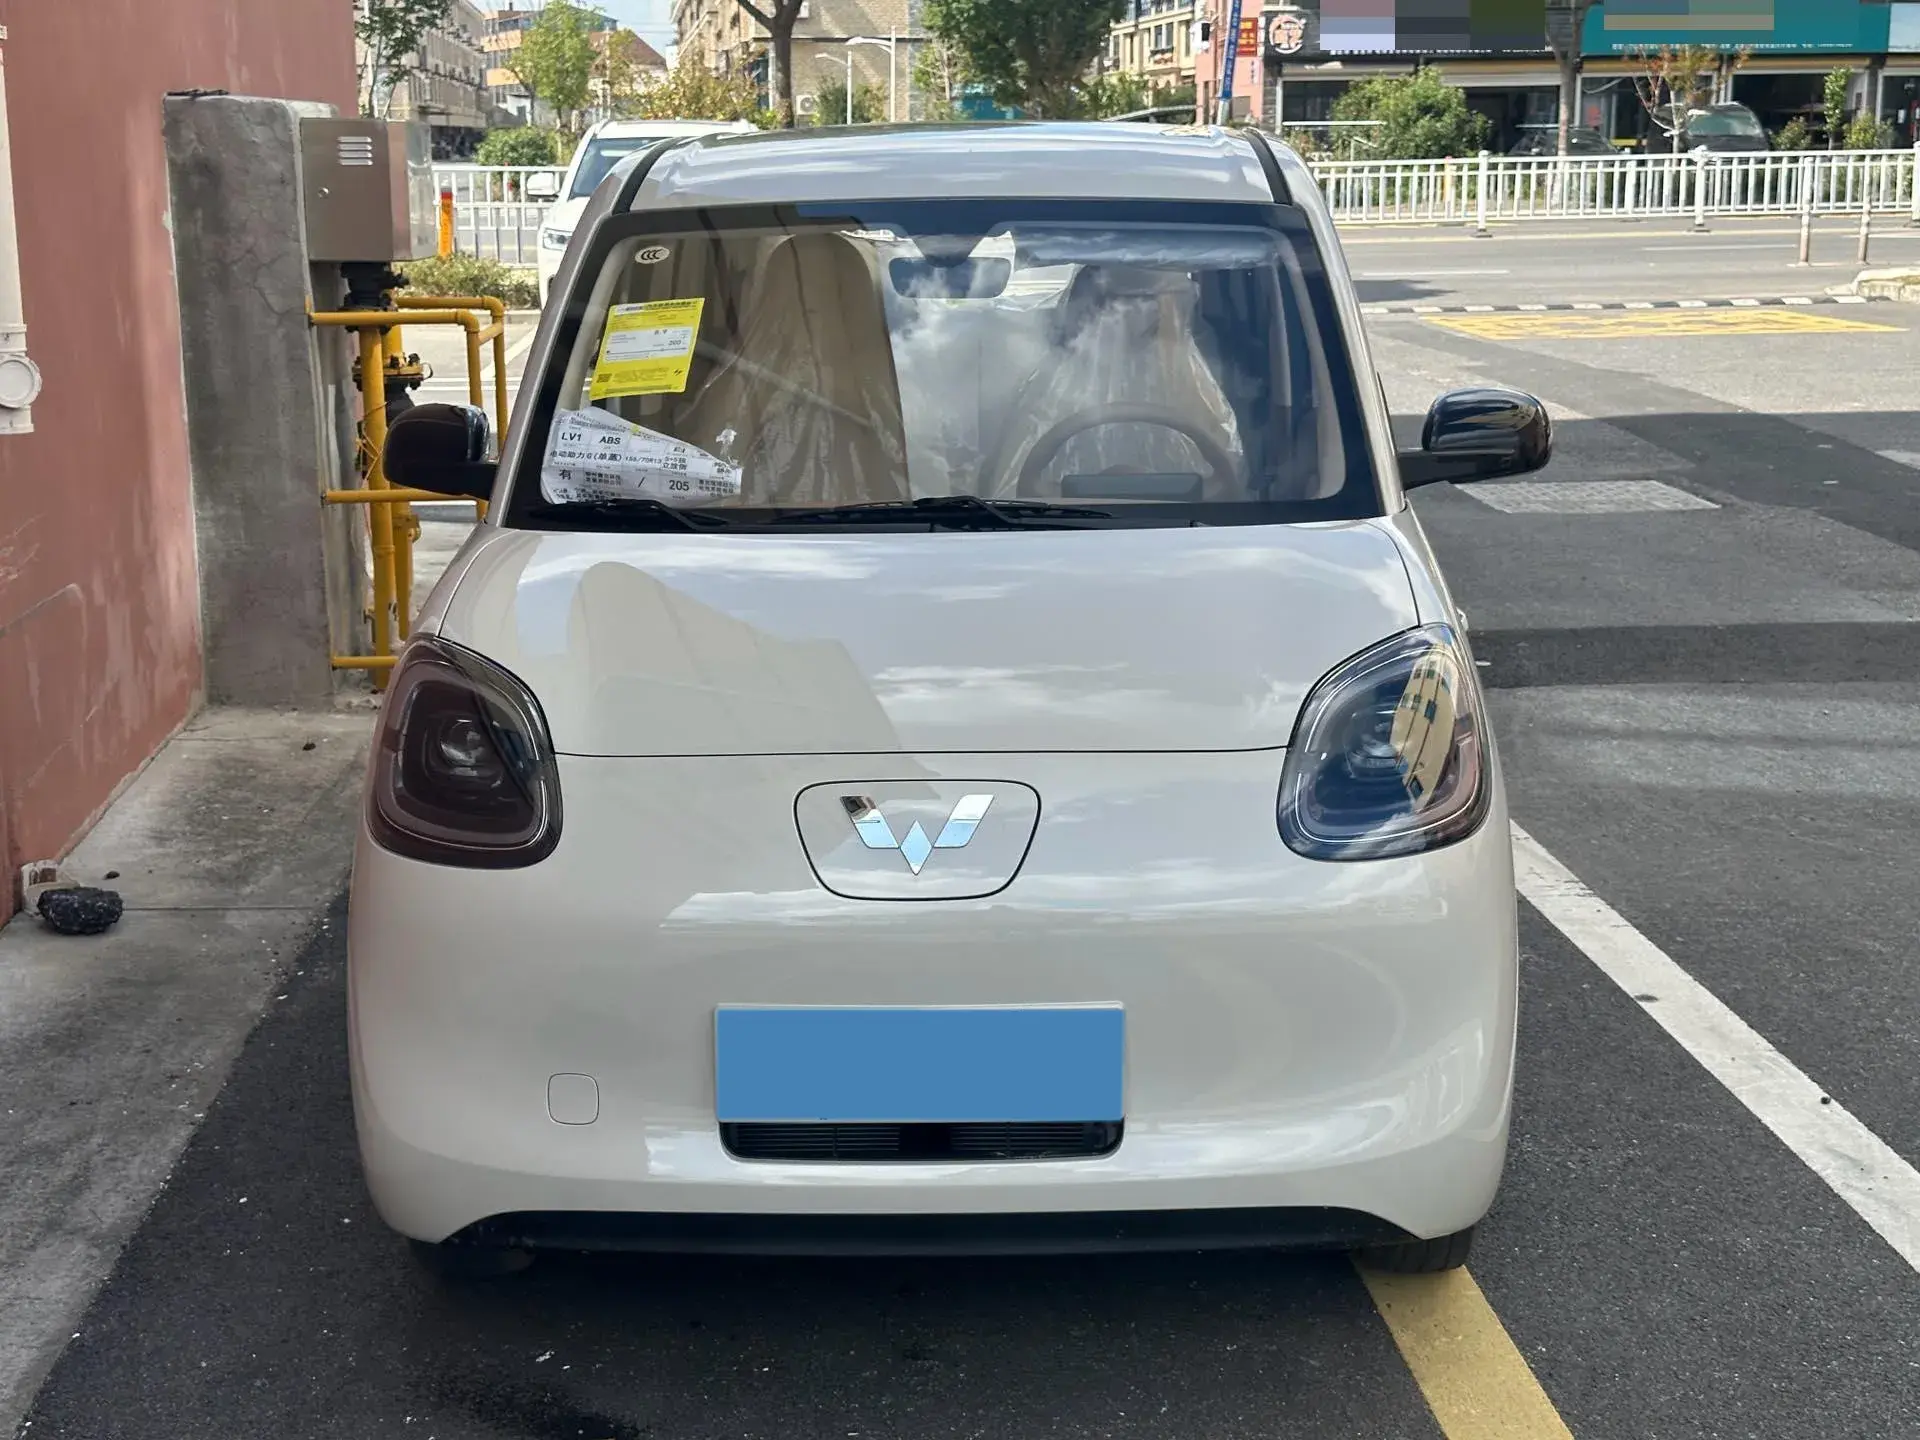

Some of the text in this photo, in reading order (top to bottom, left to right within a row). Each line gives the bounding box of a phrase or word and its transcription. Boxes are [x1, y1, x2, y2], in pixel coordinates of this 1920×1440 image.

[561, 431, 582, 441] LV1
[599, 435, 621, 445] ABS
[559, 469, 572, 481] 有
[669, 479, 690, 491] 205
